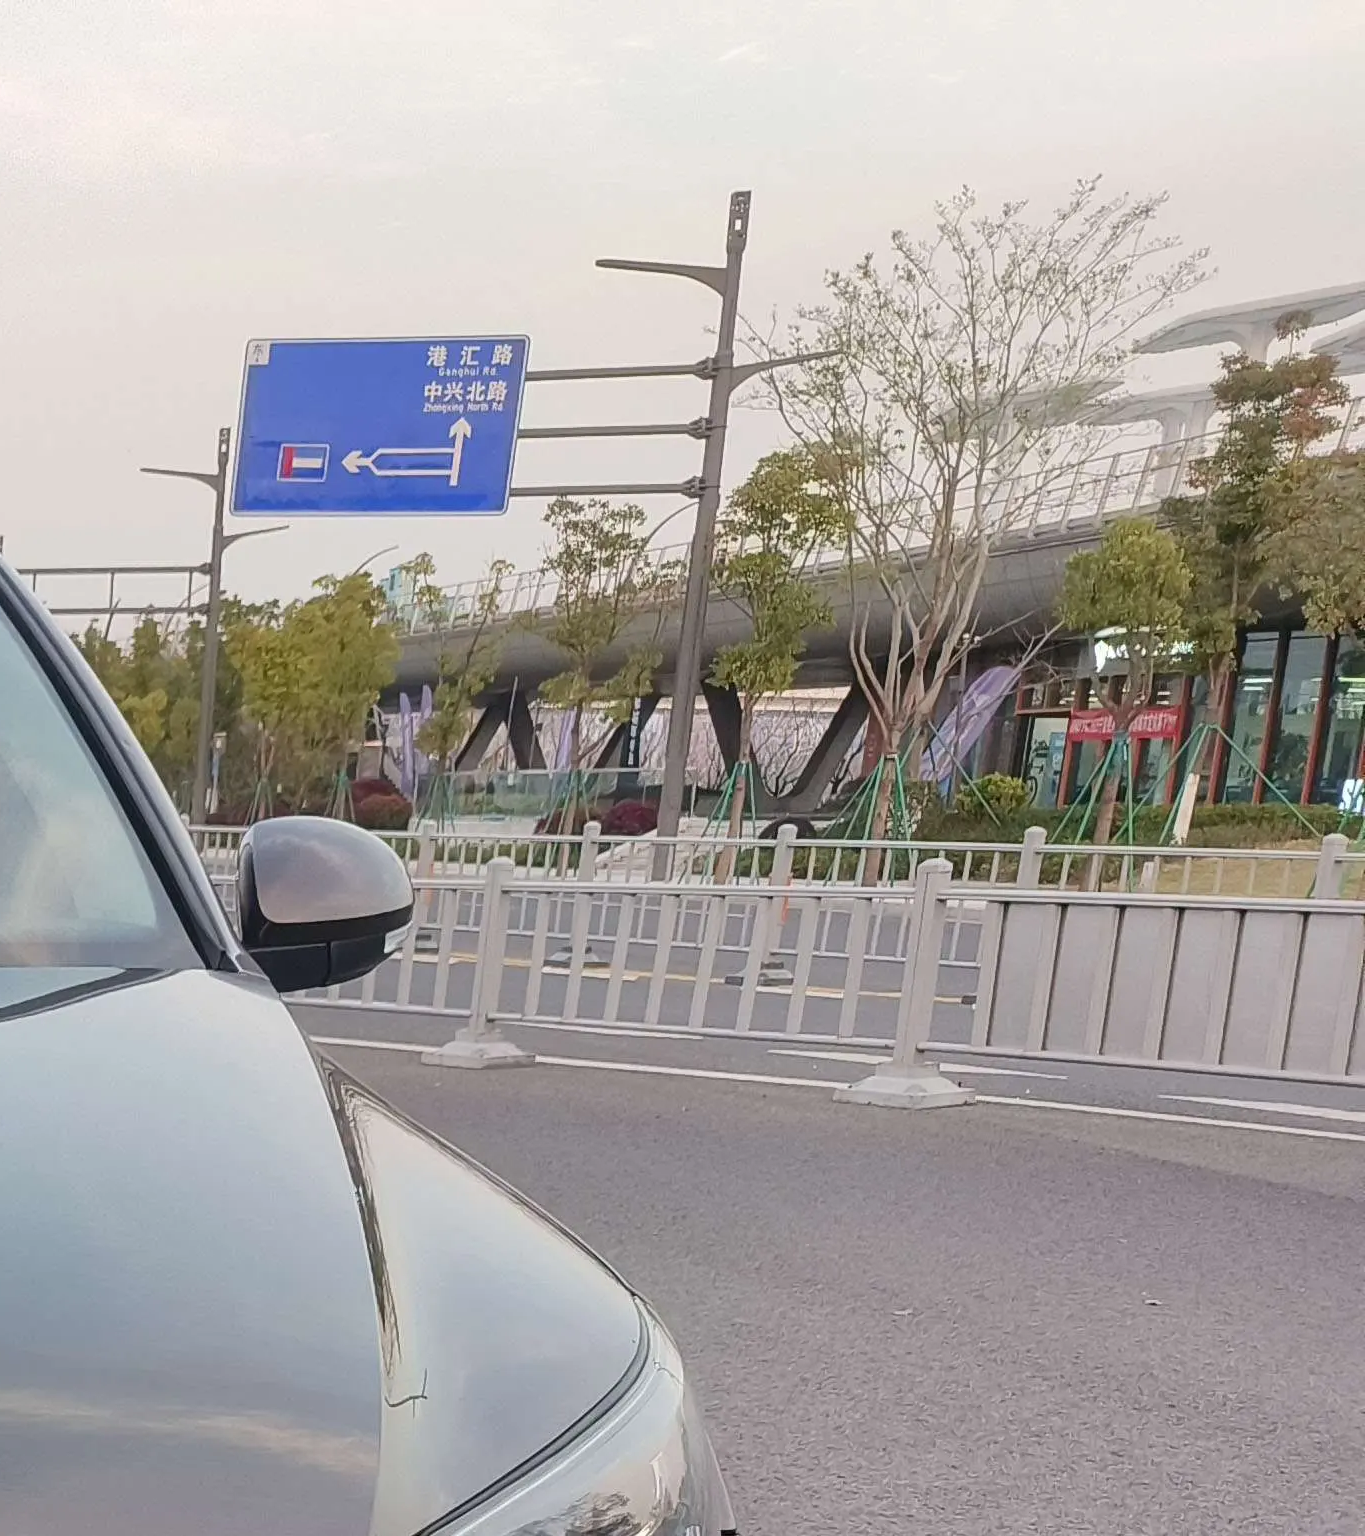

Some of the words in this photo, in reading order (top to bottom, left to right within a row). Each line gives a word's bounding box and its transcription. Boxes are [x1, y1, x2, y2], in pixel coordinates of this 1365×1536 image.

[426, 344, 512, 367] 港汇路
[438, 367, 479, 378] Ganghui
[424, 380, 507, 402] 中兴北路
